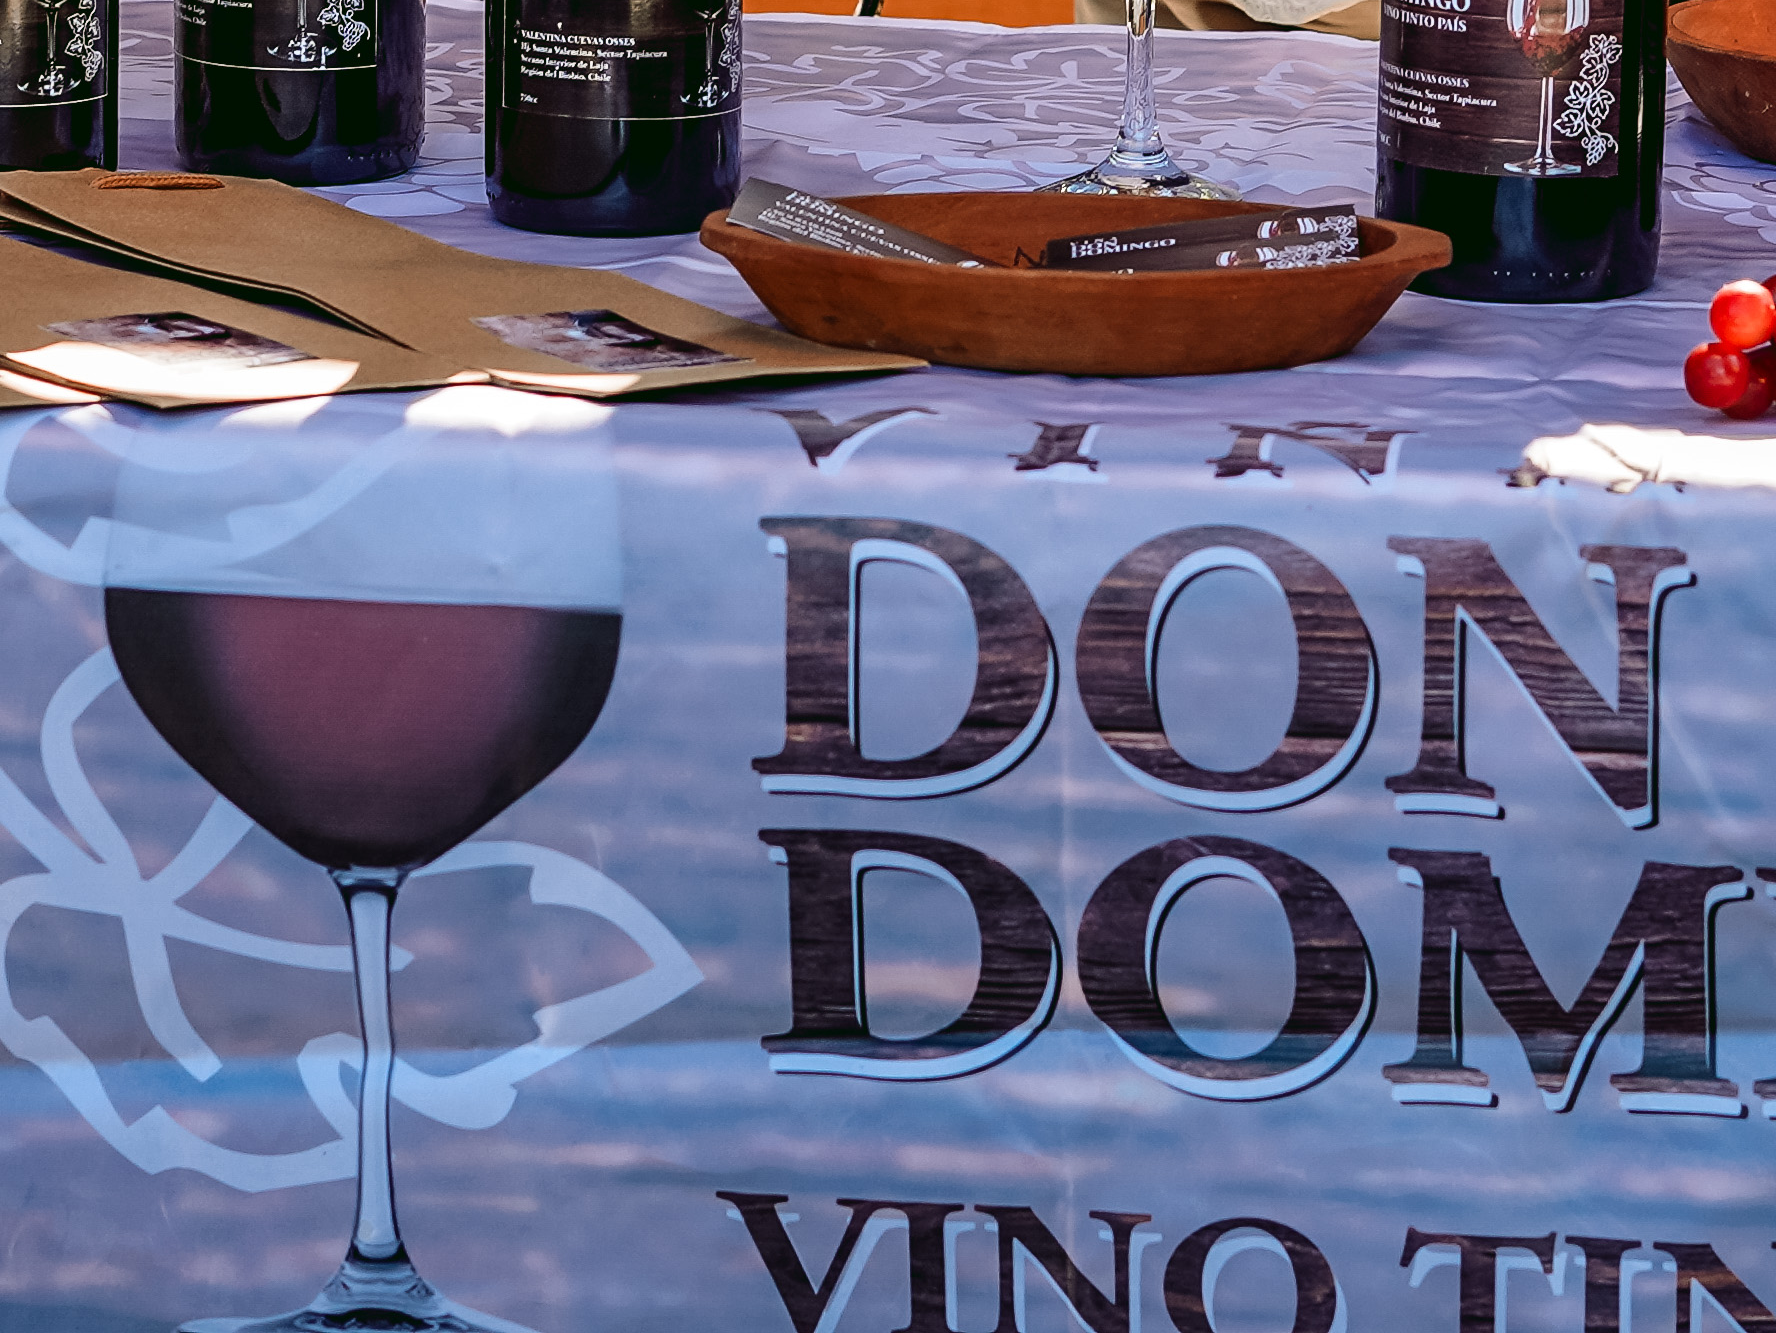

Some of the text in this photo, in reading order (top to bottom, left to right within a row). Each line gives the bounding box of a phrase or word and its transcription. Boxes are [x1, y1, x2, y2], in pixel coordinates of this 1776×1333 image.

[567, 34, 603, 46] CUEVAS
[605, 37, 636, 47] OSSES
[1400, 8, 1435, 28] TINTO
[1437, 15, 1467, 32] PAÍS
[754, 405, 1688, 495] VIÑ
[751, 515, 1697, 830] DON
[716, 1190, 1348, 1333] VINO
